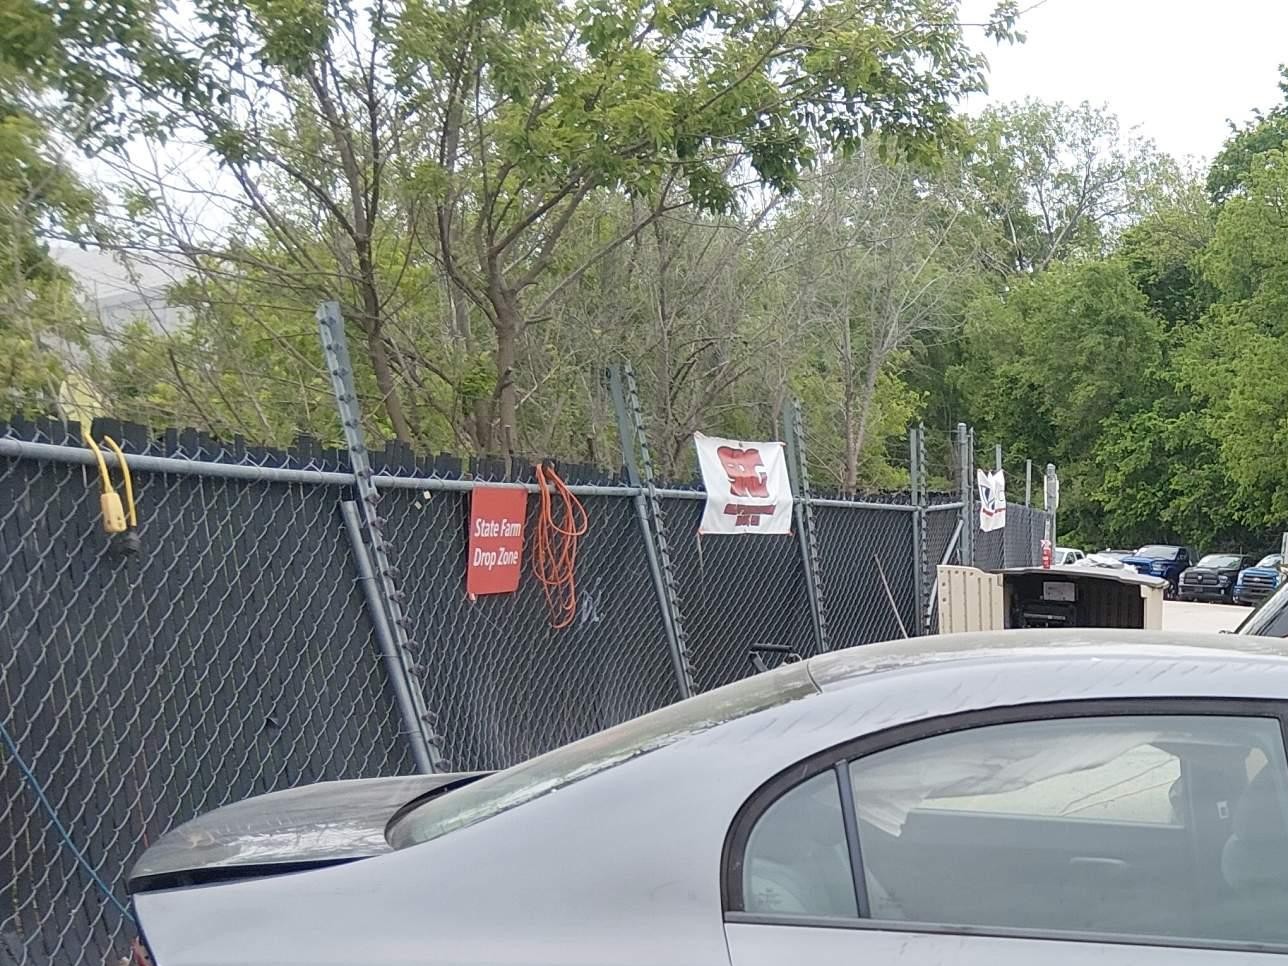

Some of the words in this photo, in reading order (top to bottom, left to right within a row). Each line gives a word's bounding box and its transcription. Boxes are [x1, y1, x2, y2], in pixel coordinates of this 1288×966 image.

[474, 518, 499, 537] State
[500, 518, 522, 537] Farm
[473, 547, 497, 571] Drop
[497, 546, 519, 565] Zone
